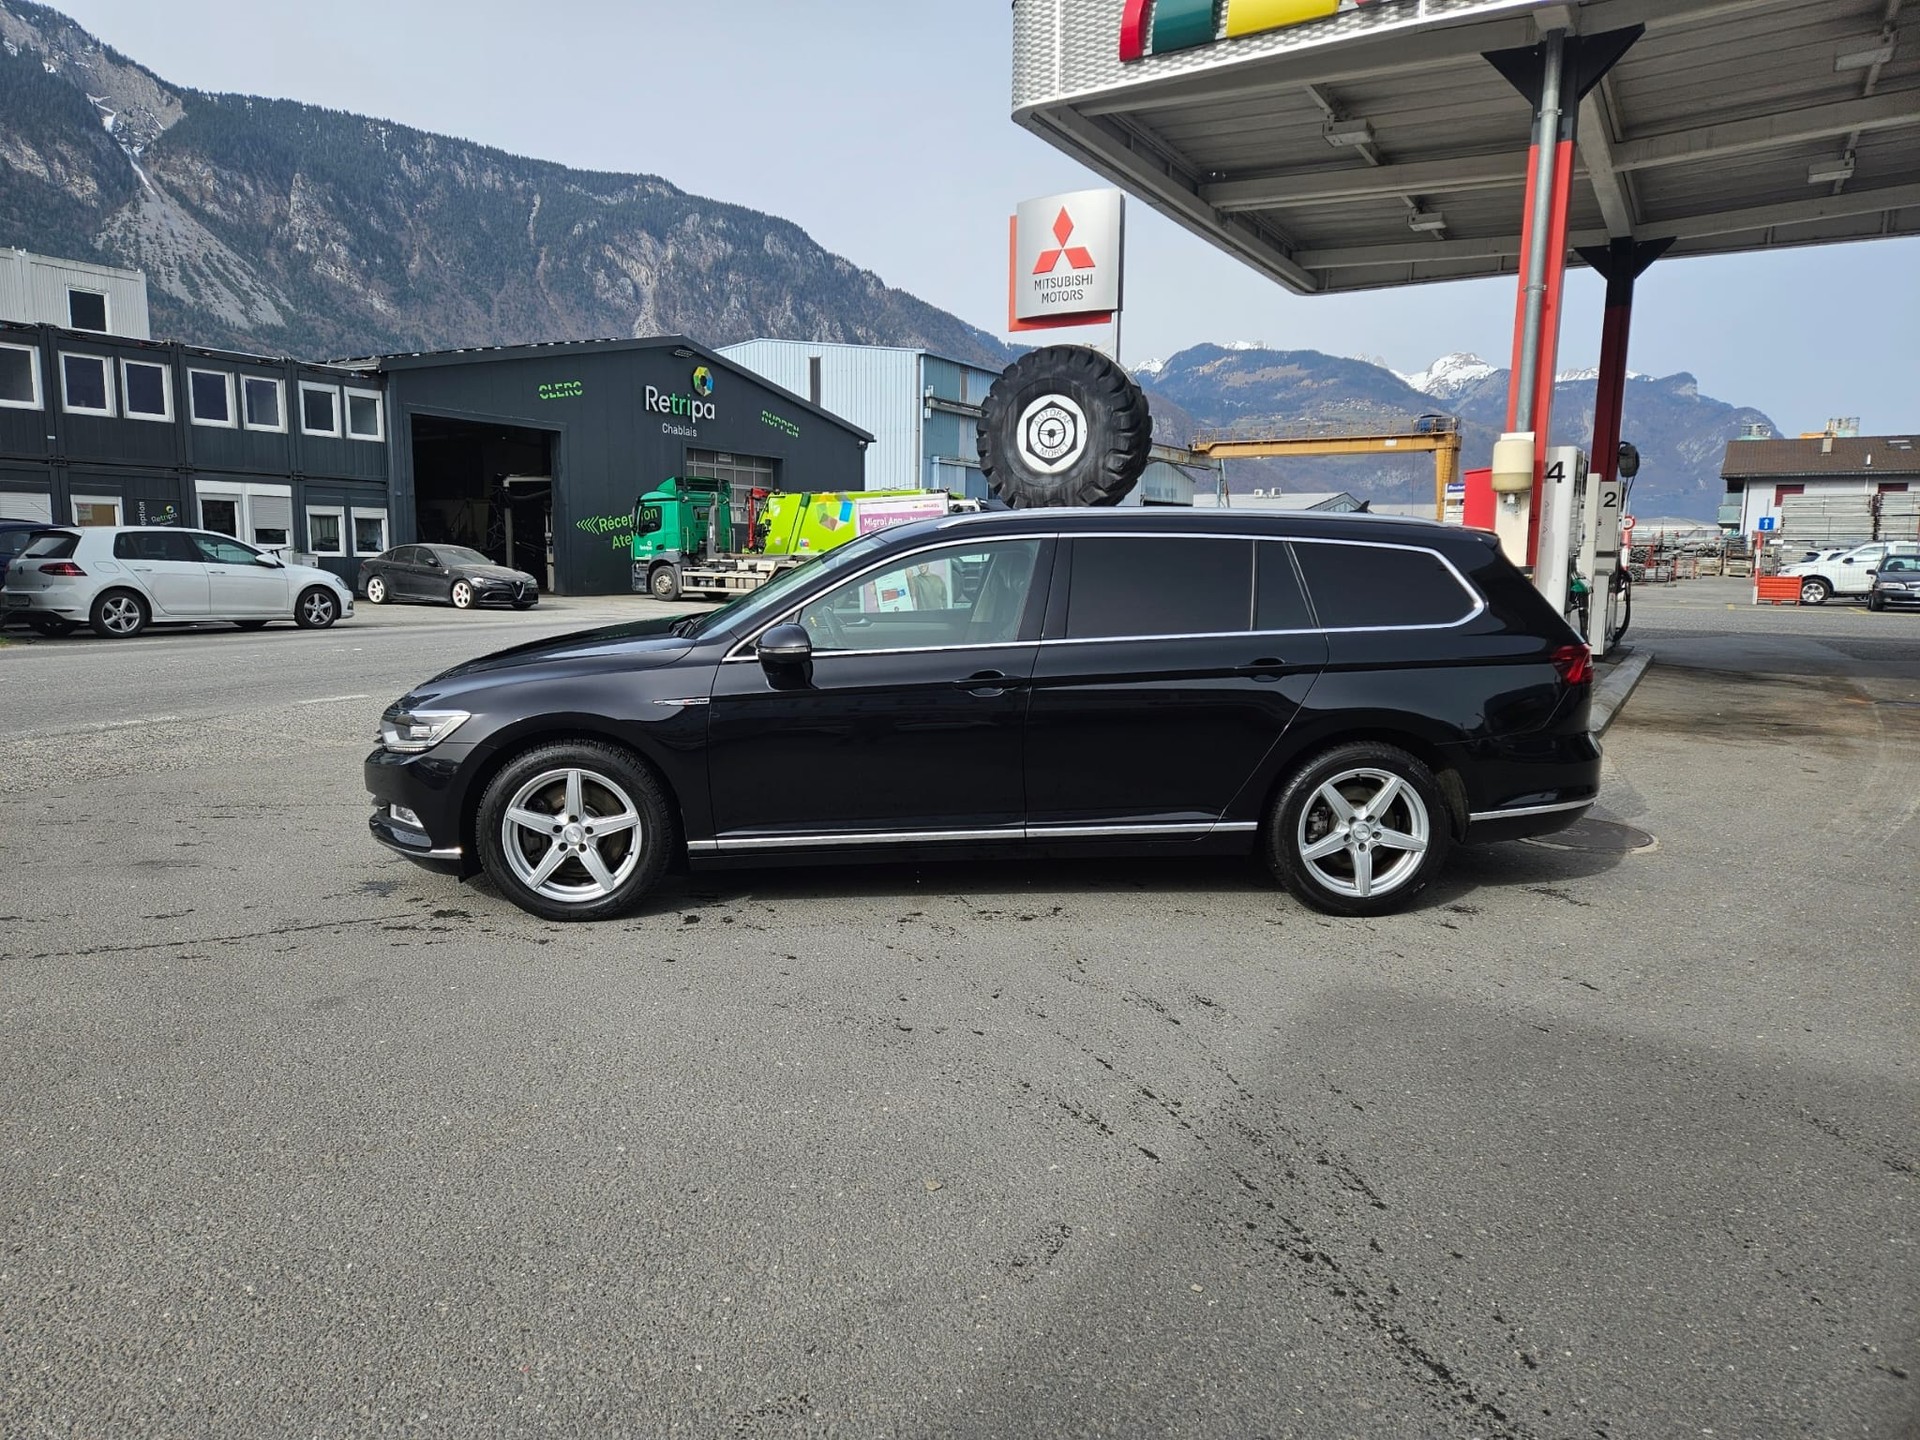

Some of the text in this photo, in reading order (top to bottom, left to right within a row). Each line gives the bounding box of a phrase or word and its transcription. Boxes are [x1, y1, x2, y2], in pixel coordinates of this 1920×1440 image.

[1034, 274, 1093, 290] MITSUBISHI
[1041, 289, 1084, 304] MOTORS
[538, 381, 583, 399] CLERC
[645, 385, 715, 423] Retripa
[662, 422, 698, 437] Chablais
[1040, 442, 1069, 457] MORET
[1546, 461, 1566, 483] 4
[1603, 491, 1617, 508] 2
[138, 501, 147, 526] eption
[864, 516, 887, 527] Migrol
[612, 530, 635, 550] Atel
